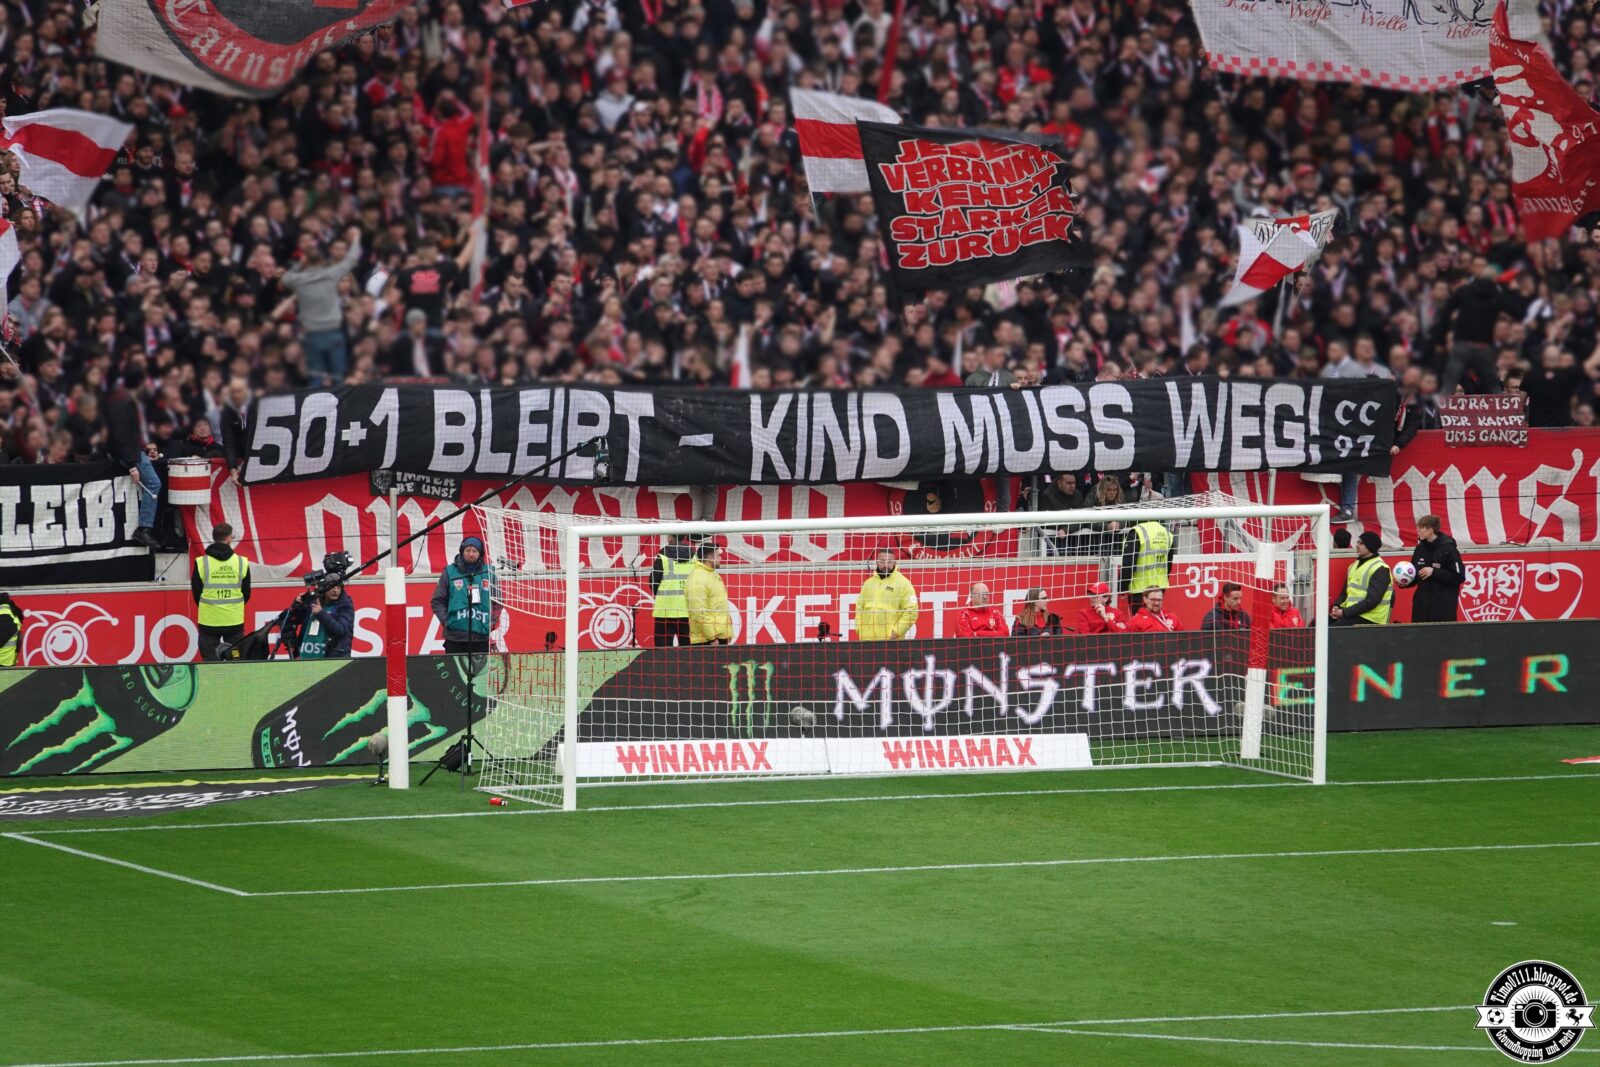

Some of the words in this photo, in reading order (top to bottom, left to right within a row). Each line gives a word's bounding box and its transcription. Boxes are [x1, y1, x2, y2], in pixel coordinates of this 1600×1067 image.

[878, 150, 1068, 193] VERBANNT
[903, 165, 1058, 214] KEHRT
[1334, 400, 1381, 426] CC
[1440, 415, 1471, 427] DER
[1477, 415, 1526, 427] KAMPF
[244, 387, 400, 483] 50+1
[428, 387, 655, 482] BLEIBT
[749, 392, 911, 481] KIND
[936, 383, 1136, 475] MUSS
[1165, 382, 1324, 471] WEG!
[1445, 430, 1476, 443] UMS
[1479, 429, 1528, 445] GANZE
[1334, 434, 1375, 458] 97
[396, 471, 456, 487] IMMER
[421, 484, 457, 498] UNS!
[216, 589, 232, 599] 1123
[1184, 565, 1220, 598] 35
[456, 607, 489, 623] HOST
[300, 641, 327, 654] OST
[832, 652, 1223, 732] MONSTER
[616, 741, 773, 774] WINAMAX
[882, 737, 1038, 769] WINAMAX
